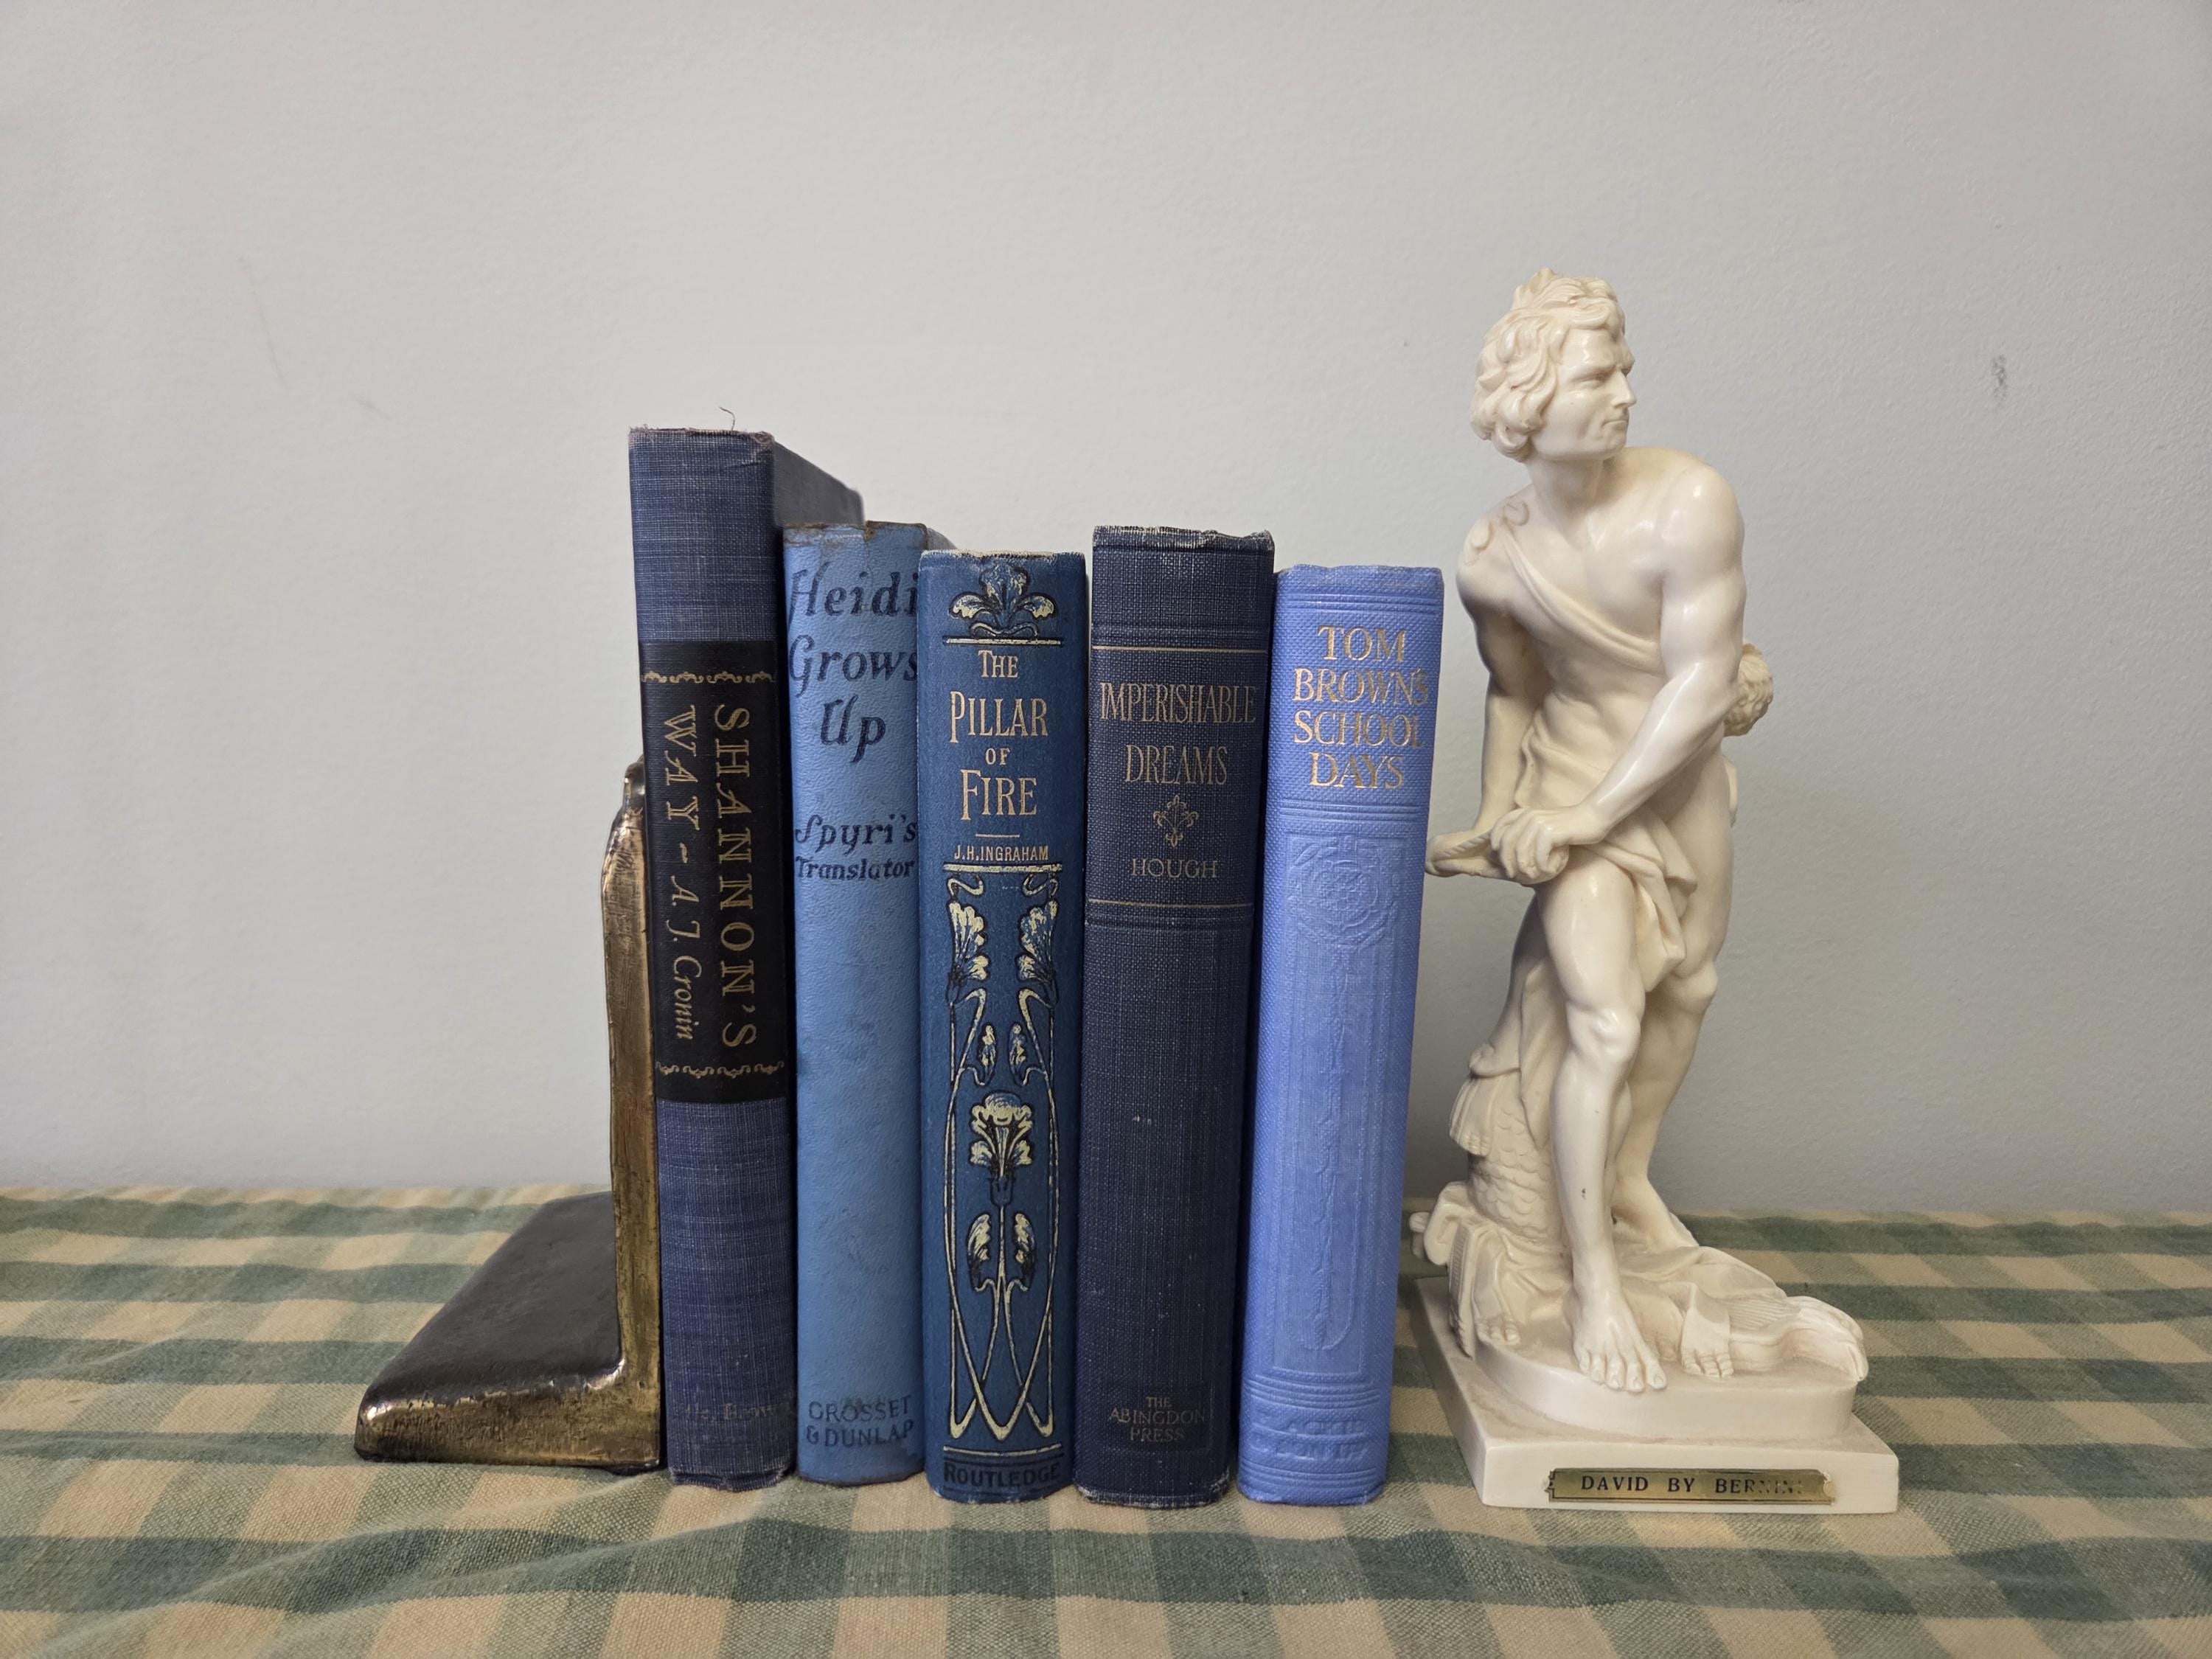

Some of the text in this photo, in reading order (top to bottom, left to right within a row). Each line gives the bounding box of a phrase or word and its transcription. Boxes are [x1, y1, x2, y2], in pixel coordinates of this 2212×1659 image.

[787, 562, 918, 627] Heidi
[1318, 625, 1405, 662] TOM
[790, 635, 917, 698] Grows
[978, 650, 1018, 678] THE
[949, 690, 1048, 743] PILLAR
[1099, 682, 1258, 723] IMPERISHABLE
[820, 695, 886, 764] Up
[1293, 709, 1422, 748] SCHOOL
[664, 705, 699, 830] WAY
[985, 747, 1010, 765] OF
[1124, 744, 1228, 785] DREAMS
[1309, 751, 1404, 789] DAYS
[960, 769, 1037, 821] FIRE
[795, 814, 917, 855] Spyri's
[714, 704, 757, 1047] SHANNON'S
[796, 855, 915, 880] Translator
[1132, 858, 1217, 878] HOUGH
[673, 955, 702, 1040] Cronin
[808, 1394, 911, 1422] GROSSET
[1108, 1406, 1205, 1425] ABINGDON
[1145, 1396, 1172, 1408] THE
[1130, 1427, 1186, 1442] PRESS
[943, 1460, 1060, 1488] ROUTLEDGE
[1581, 1475, 1649, 1491] DAVID
[1667, 1478, 1695, 1492] BY
